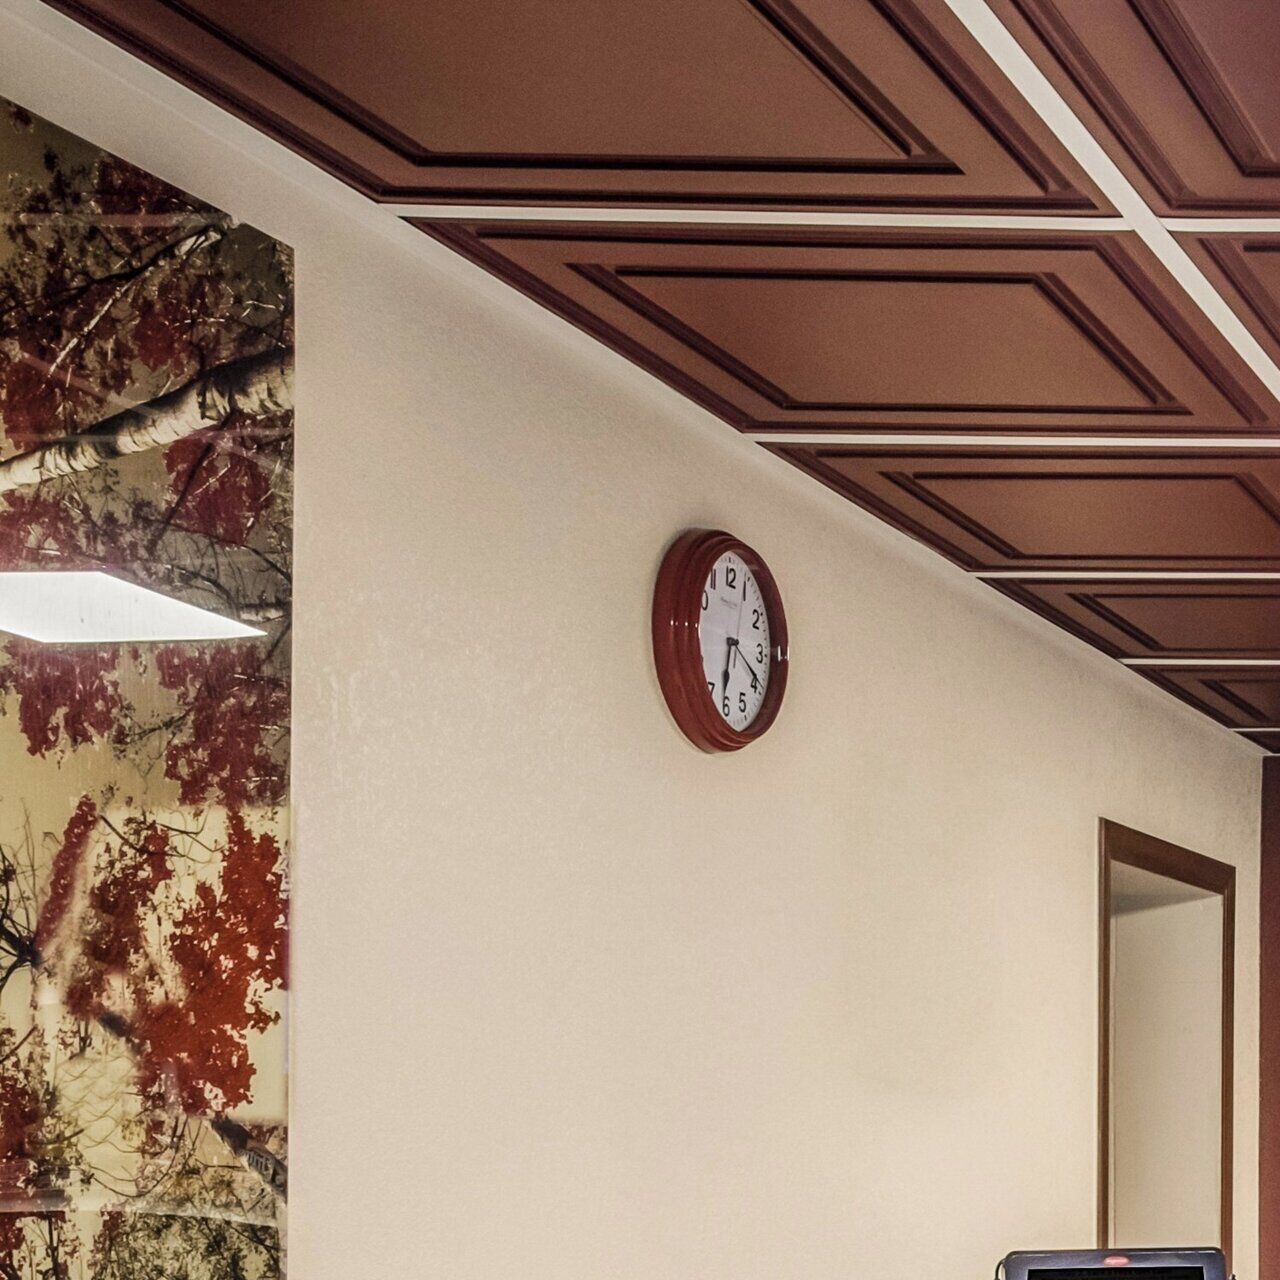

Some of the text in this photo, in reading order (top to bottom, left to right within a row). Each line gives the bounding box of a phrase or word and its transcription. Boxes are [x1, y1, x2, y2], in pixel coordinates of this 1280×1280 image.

[726, 566, 736, 589] 12
[752, 609, 760, 630] 2
[756, 643, 764, 664] 3
[750, 676, 758, 693] 4
[722, 696, 730, 717] 6
[738, 692, 747, 713] 5
